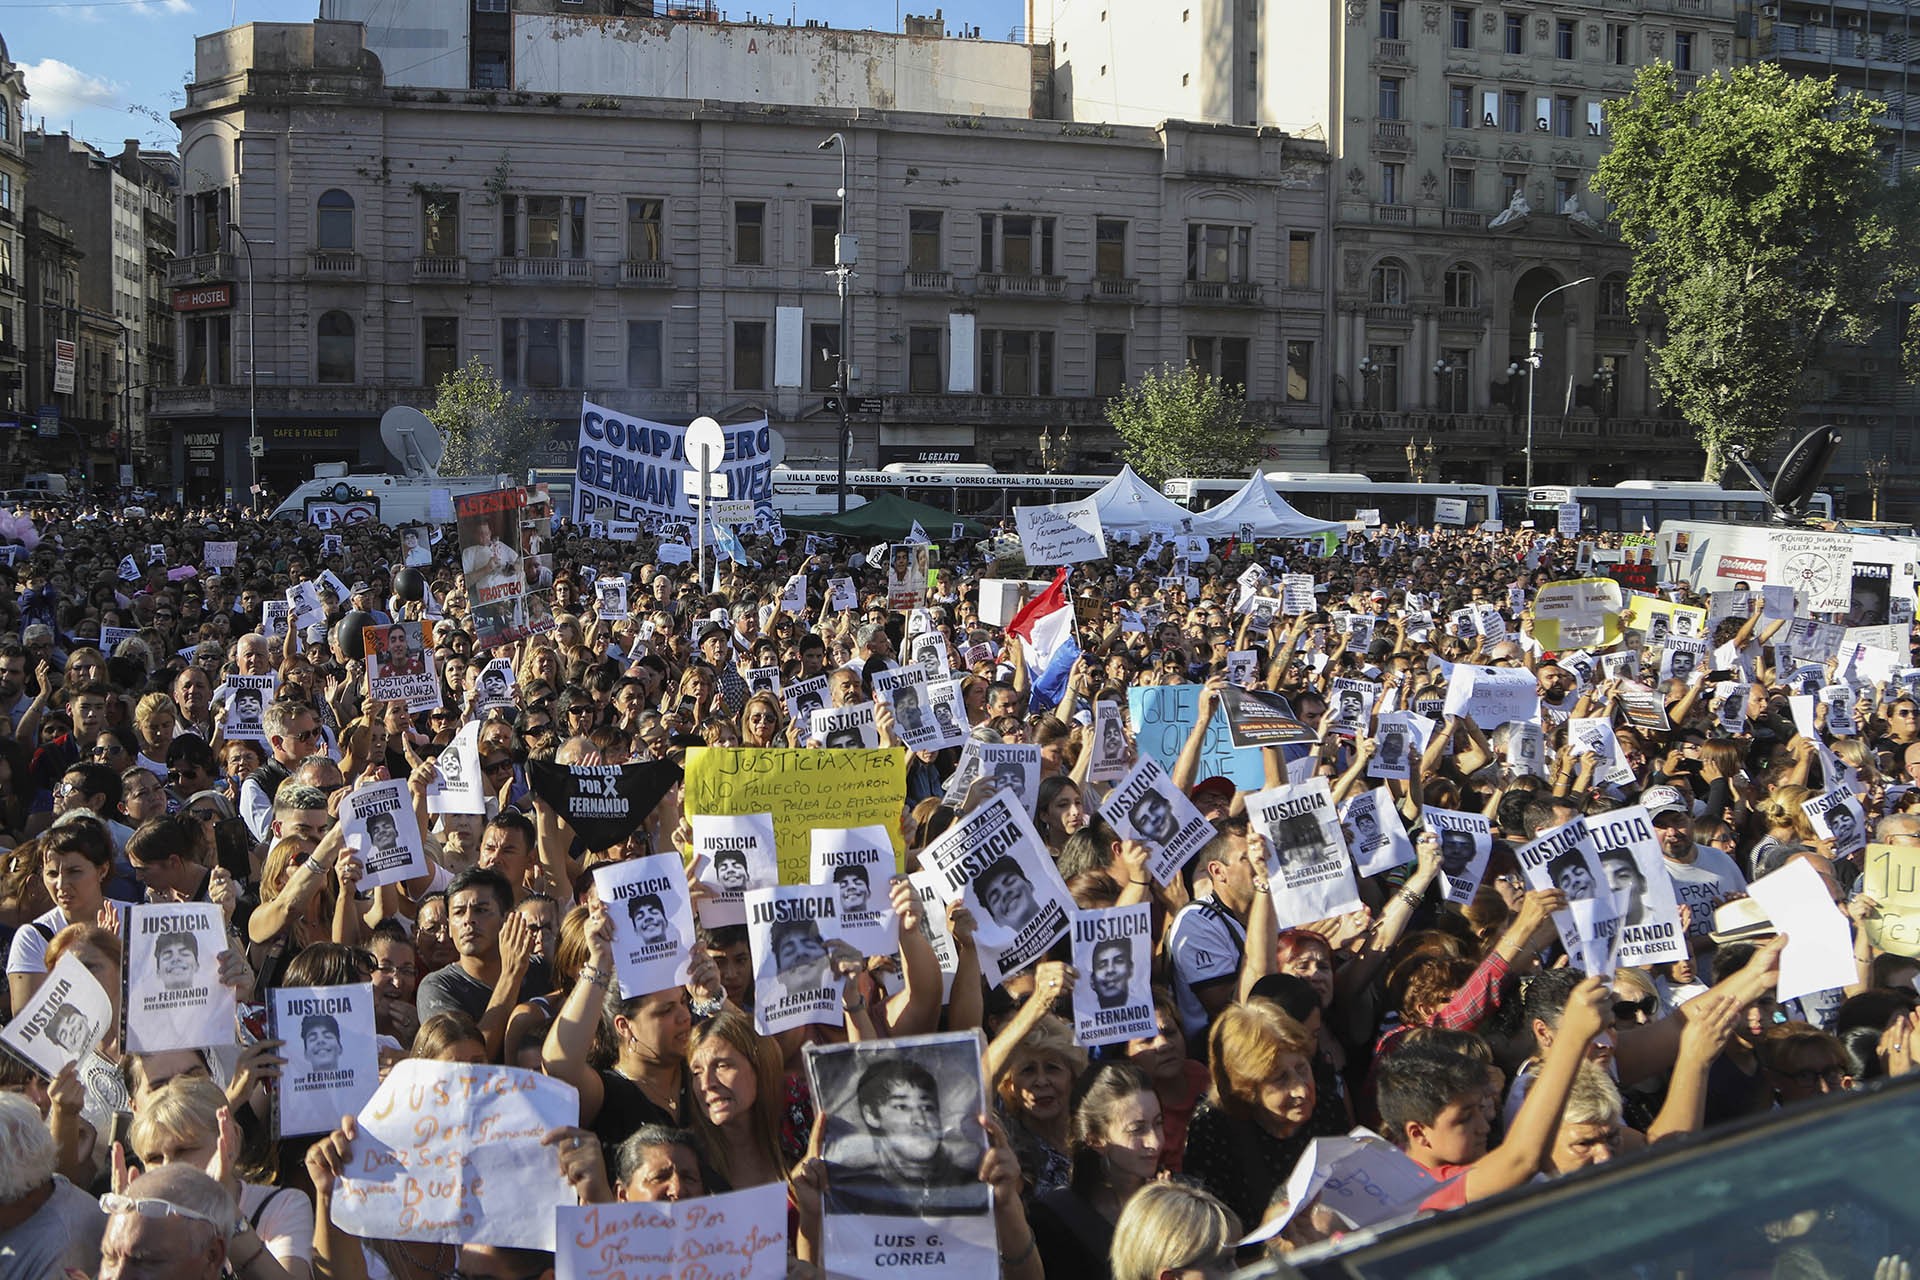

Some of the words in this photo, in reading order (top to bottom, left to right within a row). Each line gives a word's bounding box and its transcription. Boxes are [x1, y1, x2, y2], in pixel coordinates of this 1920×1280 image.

[191, 290, 226, 305] HOSTEL
[183, 433, 221, 446] MONDAY
[273, 429, 292, 437] CAFE
[303, 429, 322, 437] TAKE
[324, 429, 339, 437] OUT
[582, 409, 770, 463] COMPAERO
[928, 452, 960, 461] GELATO
[577, 446, 678, 509] GERMAN
[786, 474, 811, 482] VILLA
[815, 474, 840, 482] DEVOT
[854, 475, 892, 483] CASEROS
[905, 475, 942, 483] 105
[955, 476, 985, 485] CORREO
[987, 477, 1020, 485] CENTRAL
[1044, 478, 1074, 486] MADERO
[1166, 485, 1176, 494] 50
[458, 486, 528, 518] ASESINO
[1028, 511, 1065, 530] Justicia
[478, 581, 522, 602] PROFUGO
[596, 581, 625, 590] JUSTICIA
[1819, 598, 1850, 608] ANGEL
[1664, 640, 1706, 653] JUSTICIA
[227, 678, 273, 690] JUSTICIA
[746, 668, 778, 680] JUSTICIA
[878, 670, 924, 692] JUSTICIA
[785, 678, 828, 700] JUSTICIA
[1334, 679, 1373, 693] JUSTICIA
[1142, 688, 1195, 724] QUE
[814, 709, 874, 733] JUSTICIA
[859, 751, 895, 771] FER
[984, 749, 1037, 763] JUSTICIA
[569, 765, 623, 776] JUSTICIA
[579, 779, 602, 793] POR
[700, 777, 734, 800] NO
[817, 783, 832, 794] LO
[1105, 760, 1161, 826] JUSTICIA
[354, 799, 402, 820] JUSTICIA
[569, 796, 629, 813] FERNANDO
[826, 798, 841, 810] LO
[1262, 792, 1328, 823] JUSTICIA
[1806, 785, 1853, 817] JUSTICIA
[1426, 812, 1489, 835] JUSTICIA
[704, 836, 758, 850] JUSTICIA
[1161, 816, 1205, 862] FERNANDO
[1520, 819, 1592, 870] JUSTICIA
[1590, 817, 1653, 852] TICIA
[375, 846, 409, 860] FERNANDO
[822, 849, 880, 866] JUSTICIA
[944, 821, 1024, 893] JUSTICIA
[1296, 860, 1343, 879] FERNANDO
[612, 876, 672, 901] JUSTICIA
[1679, 880, 1722, 902] PRAY
[752, 896, 836, 925] JUSTICIA
[141, 914, 210, 935] JUSTICIA
[1014, 898, 1057, 947] FERNANDO
[1075, 913, 1149, 943] JUSTICIA
[1622, 922, 1675, 944] NANDO
[640, 940, 679, 955] FERNANDO
[1644, 940, 1678, 954] GESELL
[143, 994, 157, 1004] por
[158, 987, 209, 1002] FERNANDO
[764, 1002, 777, 1014] por
[779, 988, 836, 1008] FERNANDO
[18, 978, 73, 1044] JUSTICIA
[286, 996, 353, 1017] JUSTICIA
[764, 1006, 803, 1023] ASESINADO
[802, 1005, 811, 1014] EN
[810, 1001, 834, 1012] GESELL
[1080, 1019, 1093, 1030] por
[1094, 1005, 1150, 1026] FERNANDO
[1080, 1026, 1117, 1041] ASESINADO
[1118, 1025, 1128, 1034] EN
[1128, 1020, 1154, 1032] GESELL
[293, 1076, 306, 1086] por
[307, 1069, 355, 1083] FERNANDO
[576, 1206, 677, 1248] Justicia
[874, 1235, 915, 1248] LUIS
[926, 1234, 944, 1247] G.
[875, 1252, 946, 1267] CORREA
